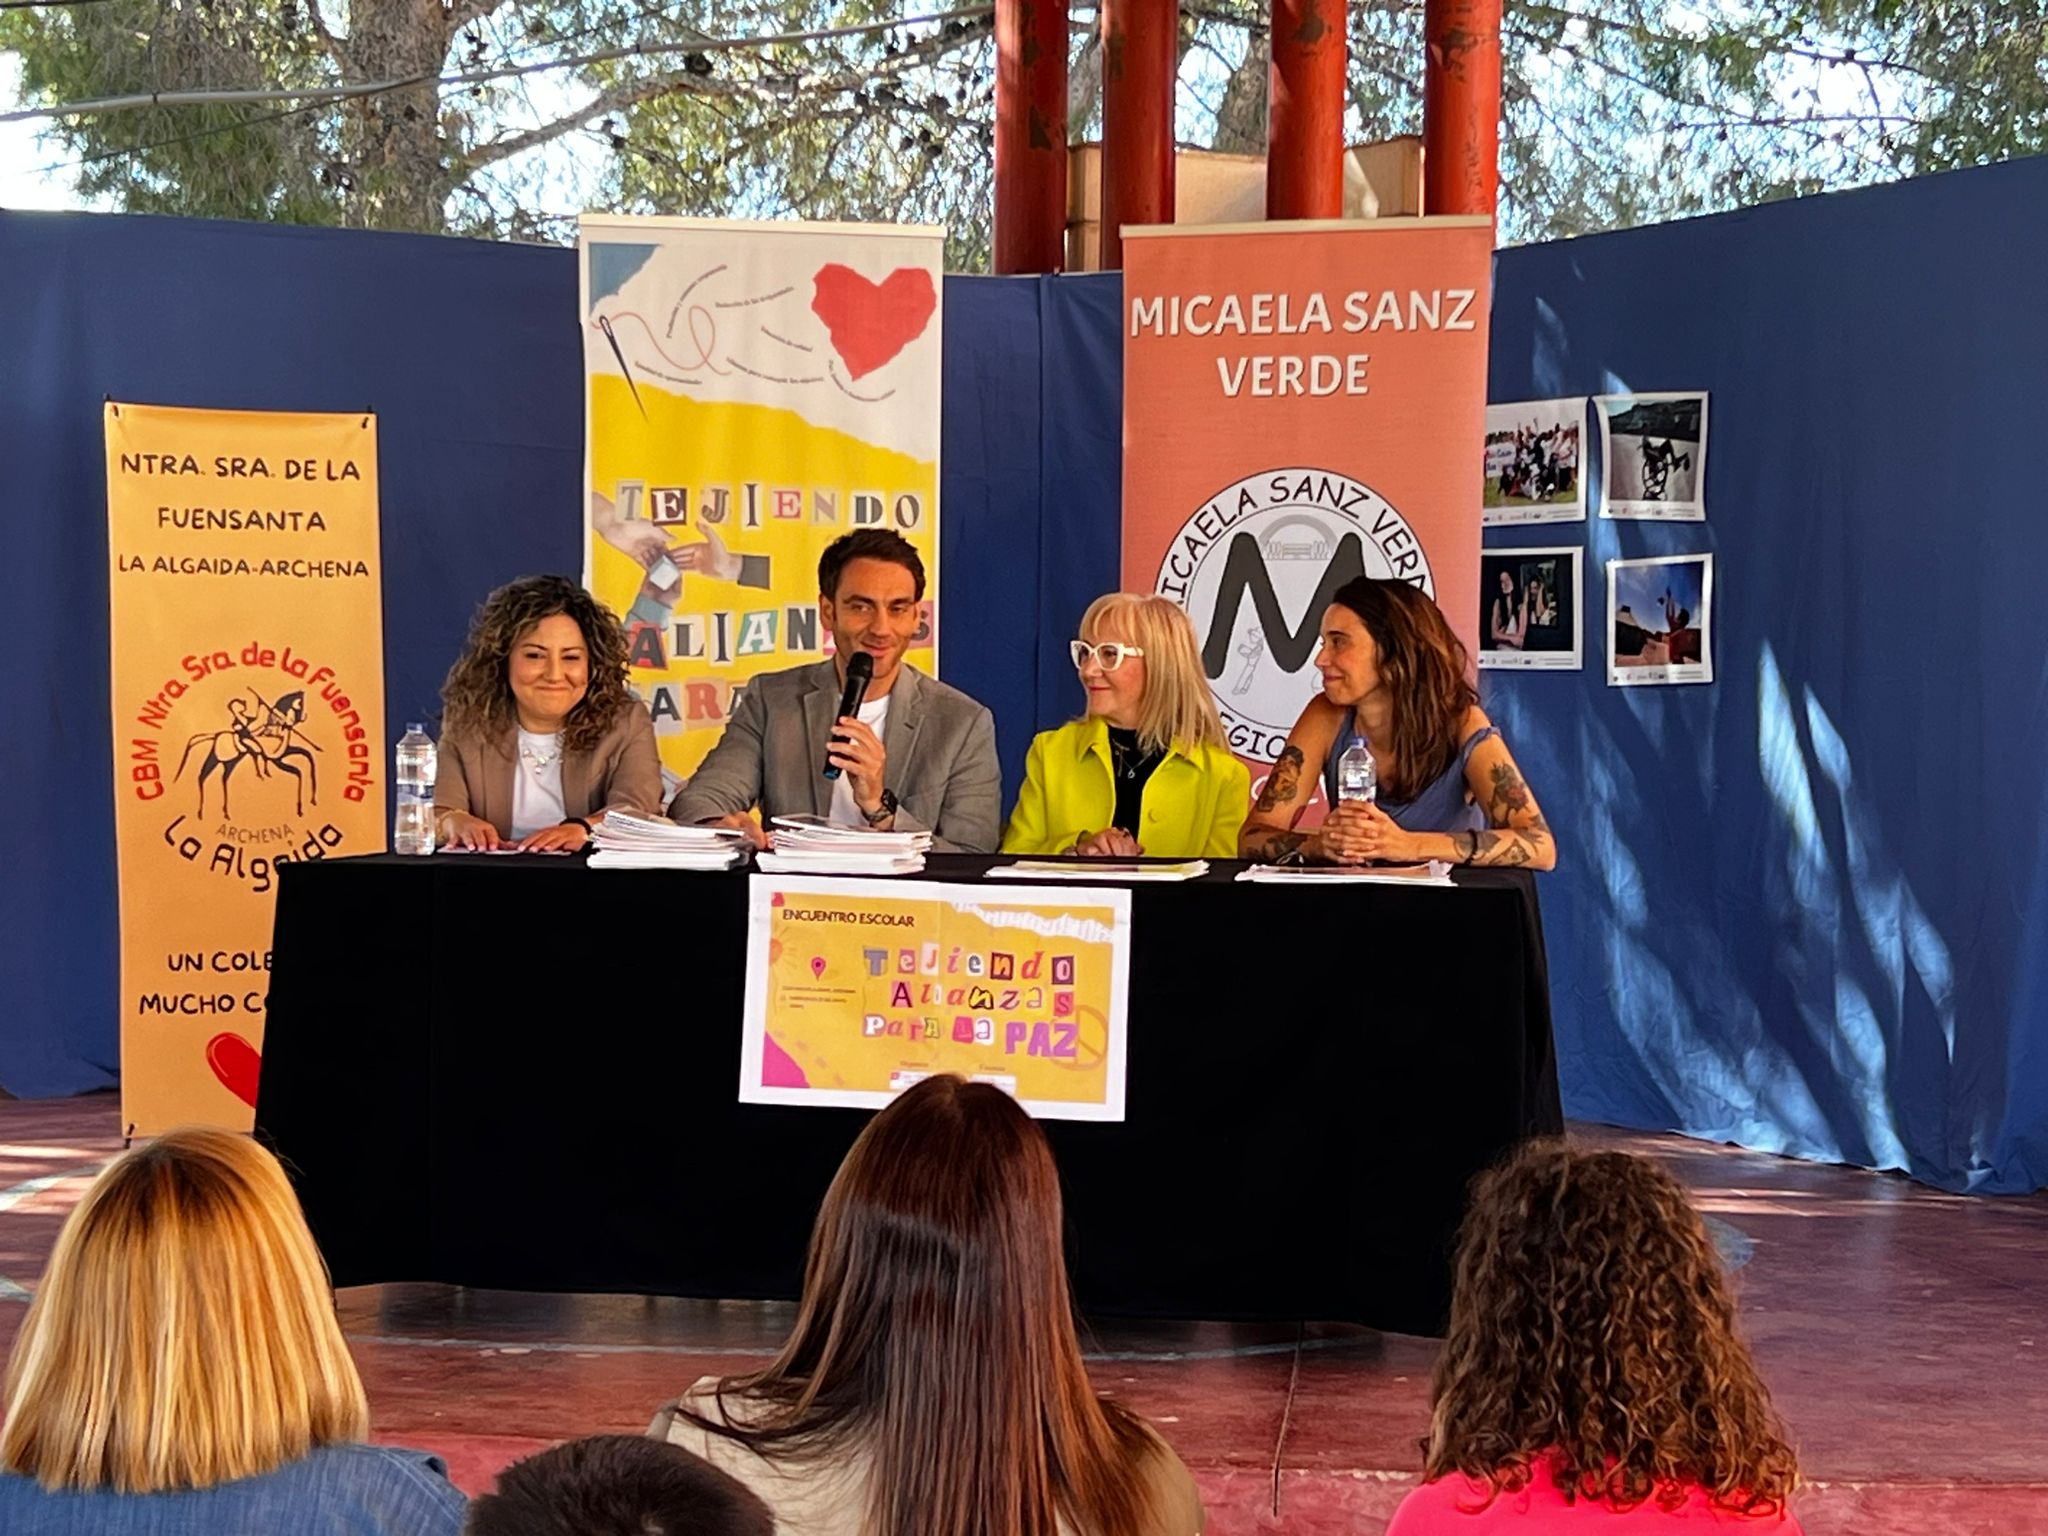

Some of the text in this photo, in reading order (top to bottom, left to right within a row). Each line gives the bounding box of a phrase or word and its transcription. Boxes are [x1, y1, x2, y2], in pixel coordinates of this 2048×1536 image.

[1131, 289, 1477, 336] MICAELA SANZ
[1216, 354, 1370, 397] VERDE
[121, 453, 361, 481] NTRA. SRA. DE LA
[158, 507, 327, 532] FUENSANTA
[619, 483, 920, 529] TEJIENDO
[1160, 487, 1258, 606] ICAELA
[1269, 475, 1370, 520] SANZ
[119, 554, 369, 578] LA ALGAIDA-ARCHENA
[241, 640, 276, 668] de
[630, 606, 930, 670] ALIANS
[181, 650, 236, 682] Sra
[137, 679, 190, 730] Ntra
[131, 738, 165, 801] CBM
[164, 814, 202, 861] La
[216, 823, 295, 845] ARCHENA
[783, 908, 915, 928] ENCUENTRO ESCOLAR
[168, 952, 203, 972] UN
[139, 993, 235, 1015] MUCHO
[1005, 1021, 1079, 1057] PAZ
